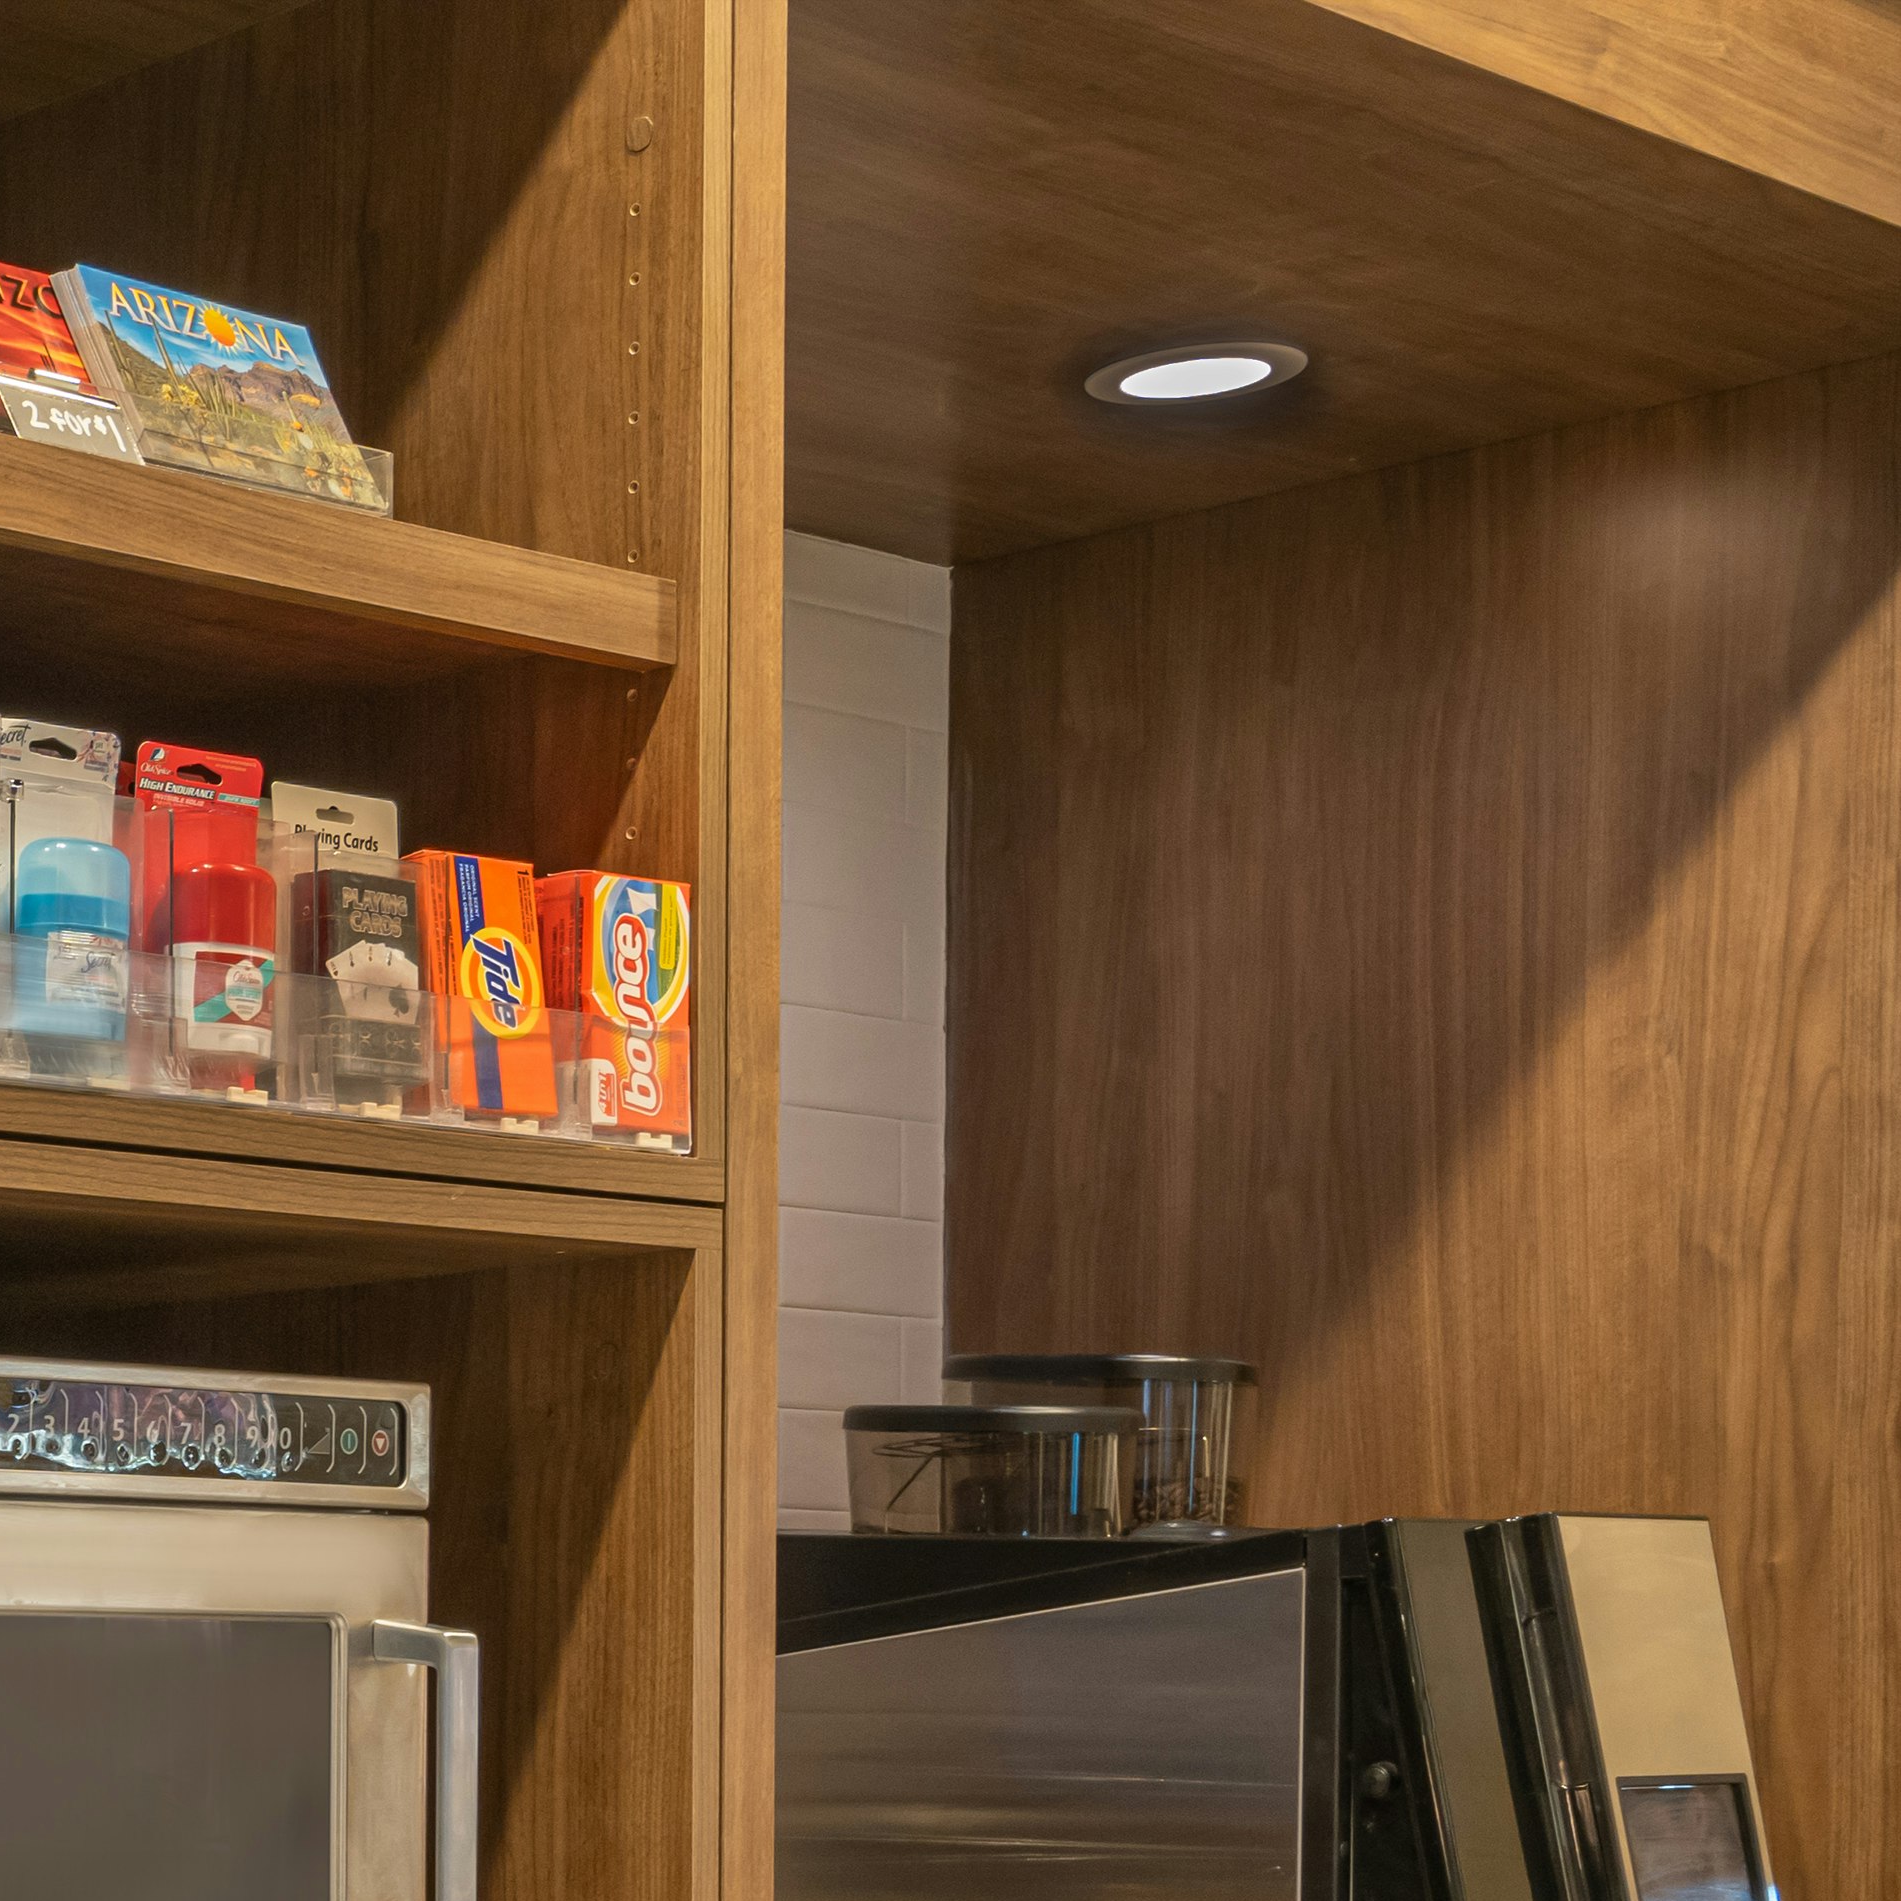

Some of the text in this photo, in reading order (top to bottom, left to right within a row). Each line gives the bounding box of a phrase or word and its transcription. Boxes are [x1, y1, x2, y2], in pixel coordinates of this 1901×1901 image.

[140, 777, 215, 800] HIGH ENDURANCE
[344, 833, 378, 852] Cards
[342, 887, 408, 916] PLAYING
[350, 911, 402, 937] CARDS
[471, 934, 518, 1029] Tide
[614, 917, 661, 1113] bounce
